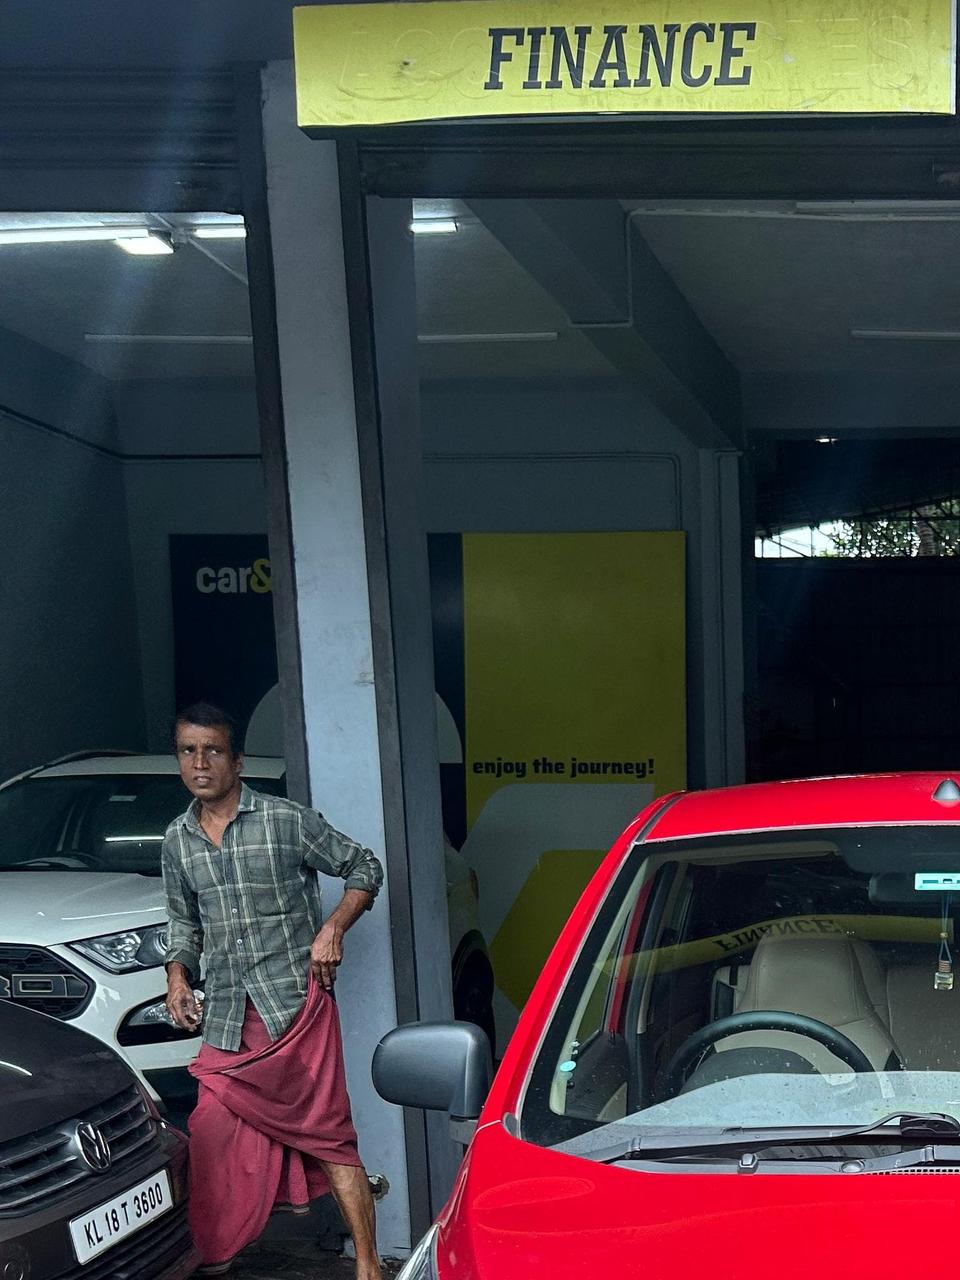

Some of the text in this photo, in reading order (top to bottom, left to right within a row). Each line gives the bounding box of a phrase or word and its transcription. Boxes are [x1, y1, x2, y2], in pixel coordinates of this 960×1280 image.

[484, 21, 757, 90] FINANCE
[472, 757, 655, 779] enjoy the journey!
[84, 1182, 163, 1248] KL 18 T 3600
